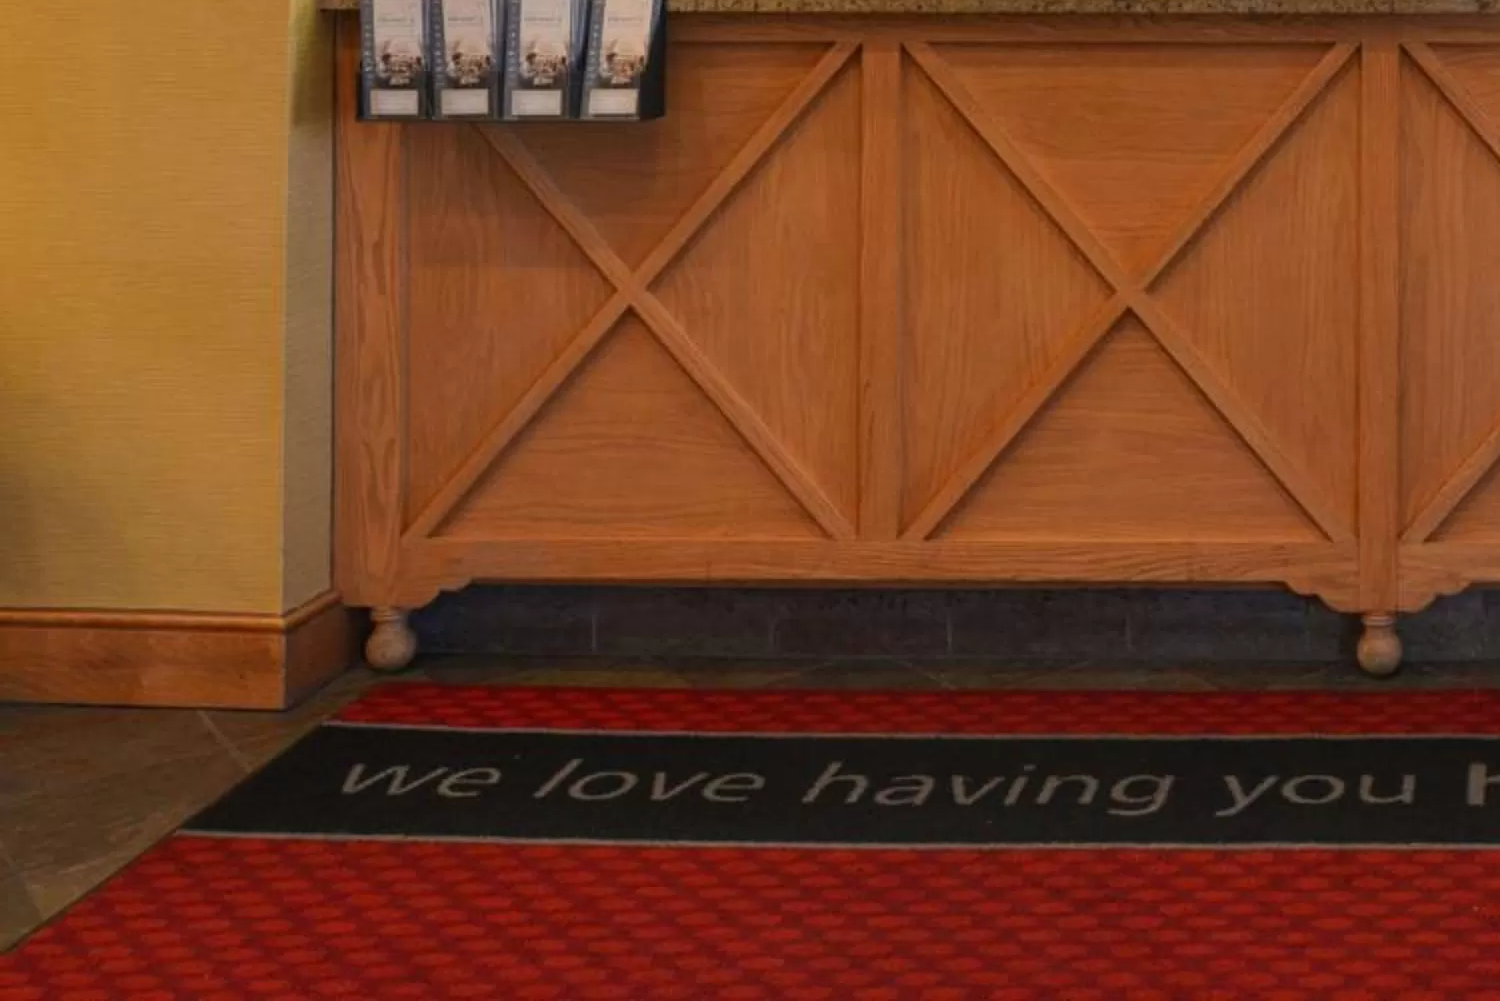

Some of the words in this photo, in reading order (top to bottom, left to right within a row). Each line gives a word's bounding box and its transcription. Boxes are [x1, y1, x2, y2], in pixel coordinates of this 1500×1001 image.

[340, 763, 501, 799] we
[532, 758, 766, 802] love
[802, 761, 1175, 817] having
[1214, 773, 1417, 817] you
